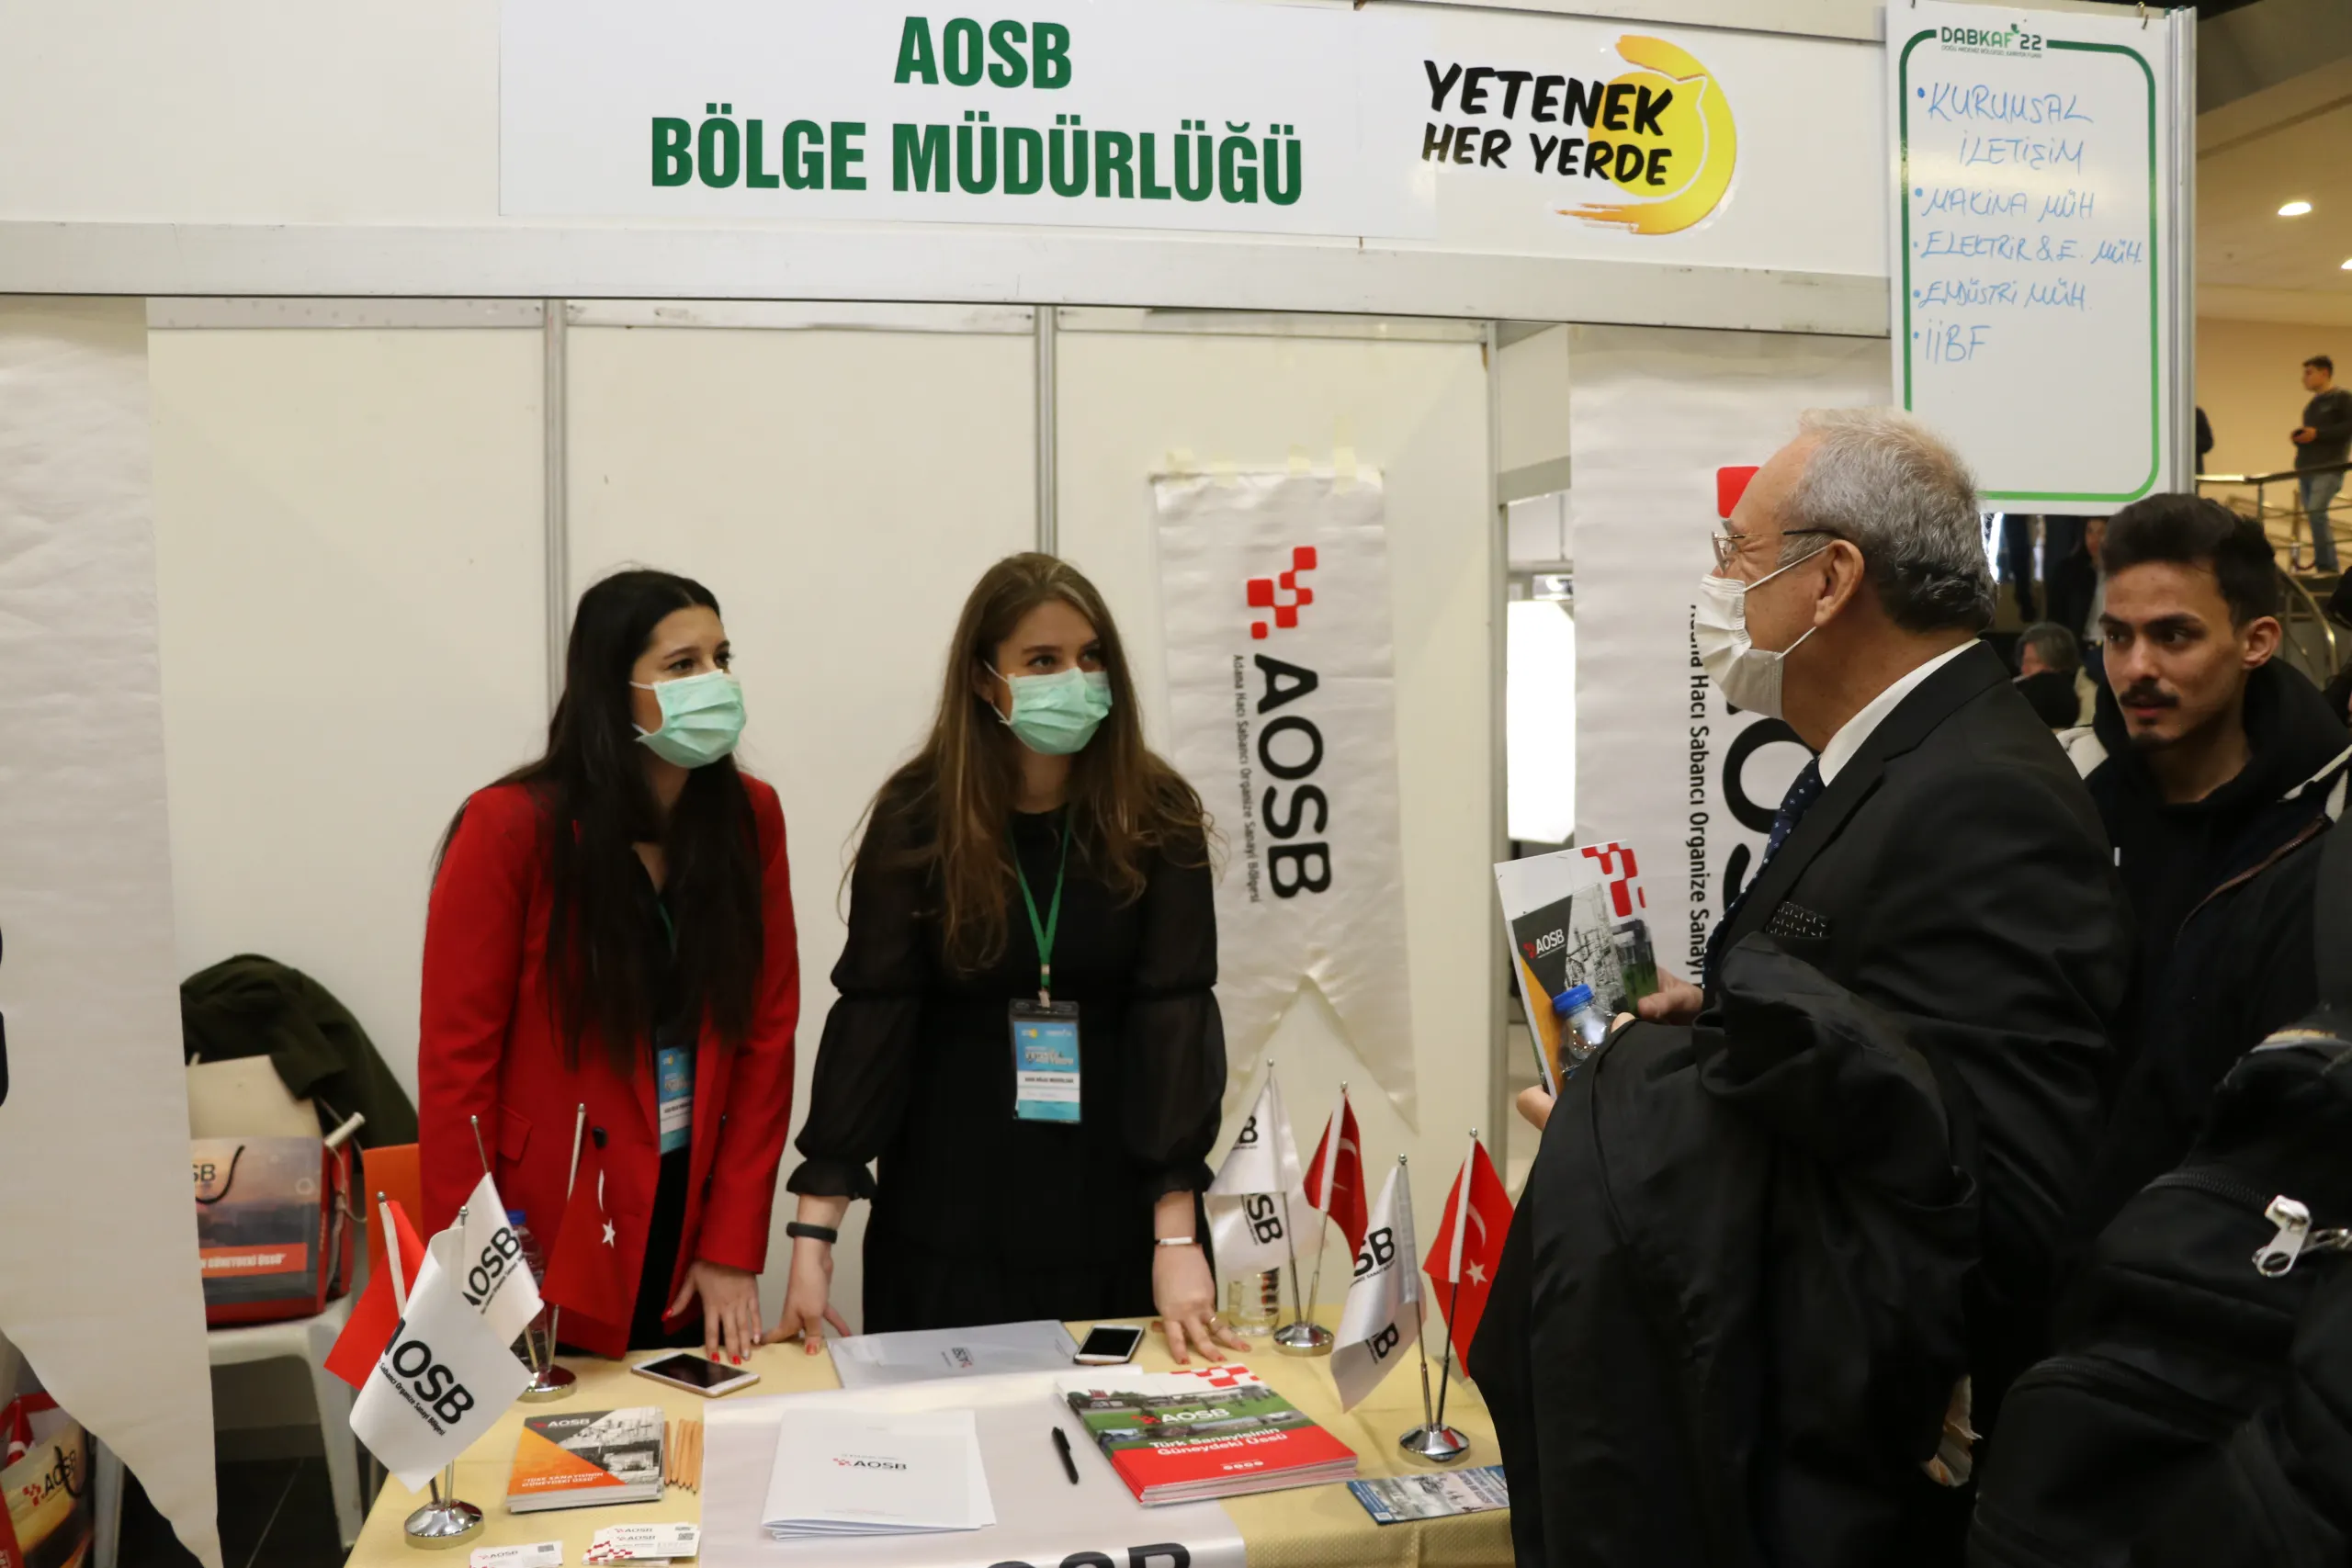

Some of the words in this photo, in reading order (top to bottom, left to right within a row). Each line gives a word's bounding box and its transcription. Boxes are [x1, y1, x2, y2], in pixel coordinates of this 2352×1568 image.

[894, 17, 1071, 90] AOSB
[1424, 60, 1673, 137] YETENEK
[1928, 83, 2094, 123] KURUMSAL
[651, 103, 866, 191] BÖLGE
[892, 110, 1302, 205] MÜDÜRLÜĞÜ
[1421, 124, 1511, 169] HER
[1529, 133, 1673, 186] YERDE
[1233, 654, 1245, 689] Adana
[1690, 675, 1709, 718] Hacı
[1254, 653, 1332, 898] AOSB
[1690, 726, 1710, 805] Sabancı
[1238, 768, 1253, 818] Organize
[1244, 821, 1259, 858] Sanayi
[1686, 812, 1710, 902] Organize
[1536, 929, 1565, 954] AOSB
[395, 1382, 416, 1405] Organize
[548, 1418, 590, 1428] AOSB
[1161, 1408, 1230, 1423] AOSB
[1149, 1439, 1187, 1450] Türk
[854, 1461, 907, 1471] AOSB
